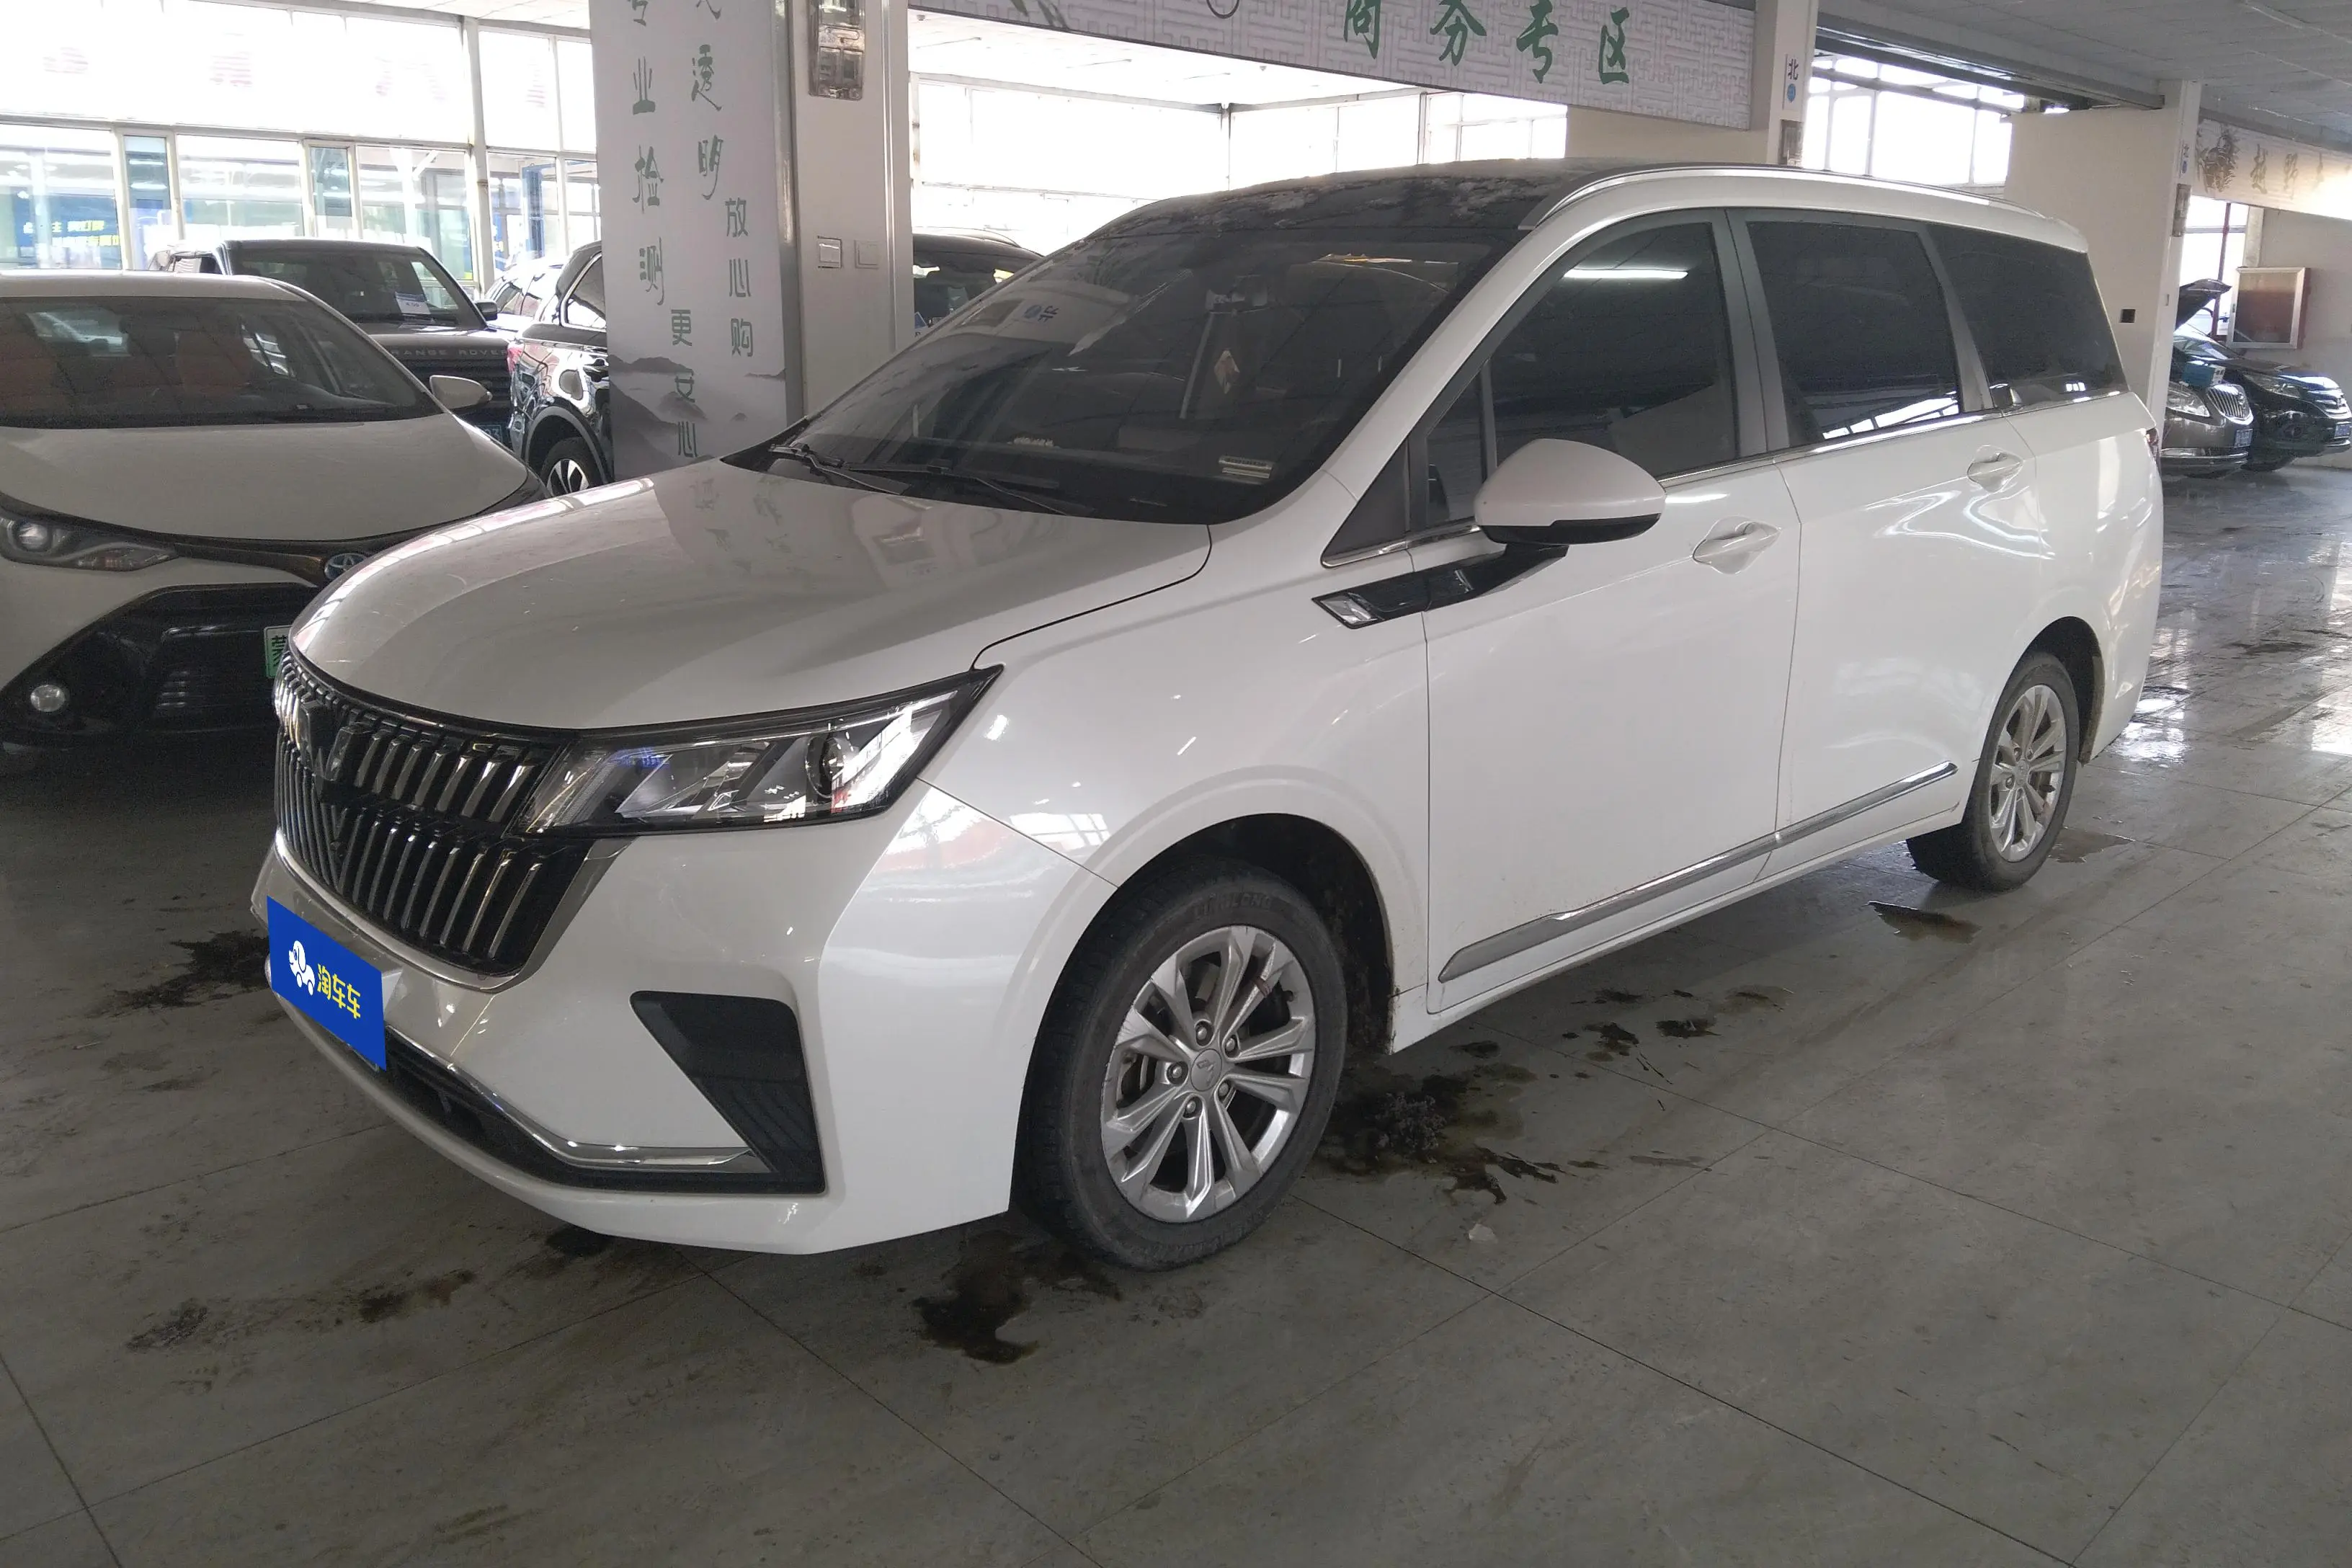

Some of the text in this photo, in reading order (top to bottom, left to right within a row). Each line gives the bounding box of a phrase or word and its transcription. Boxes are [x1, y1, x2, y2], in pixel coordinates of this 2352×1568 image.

[691, 0, 723, 200] 透明
[1788, 58, 1799, 81] 北
[725, 197, 754, 357] 放心购
[671, 309, 698, 458] 更安心
